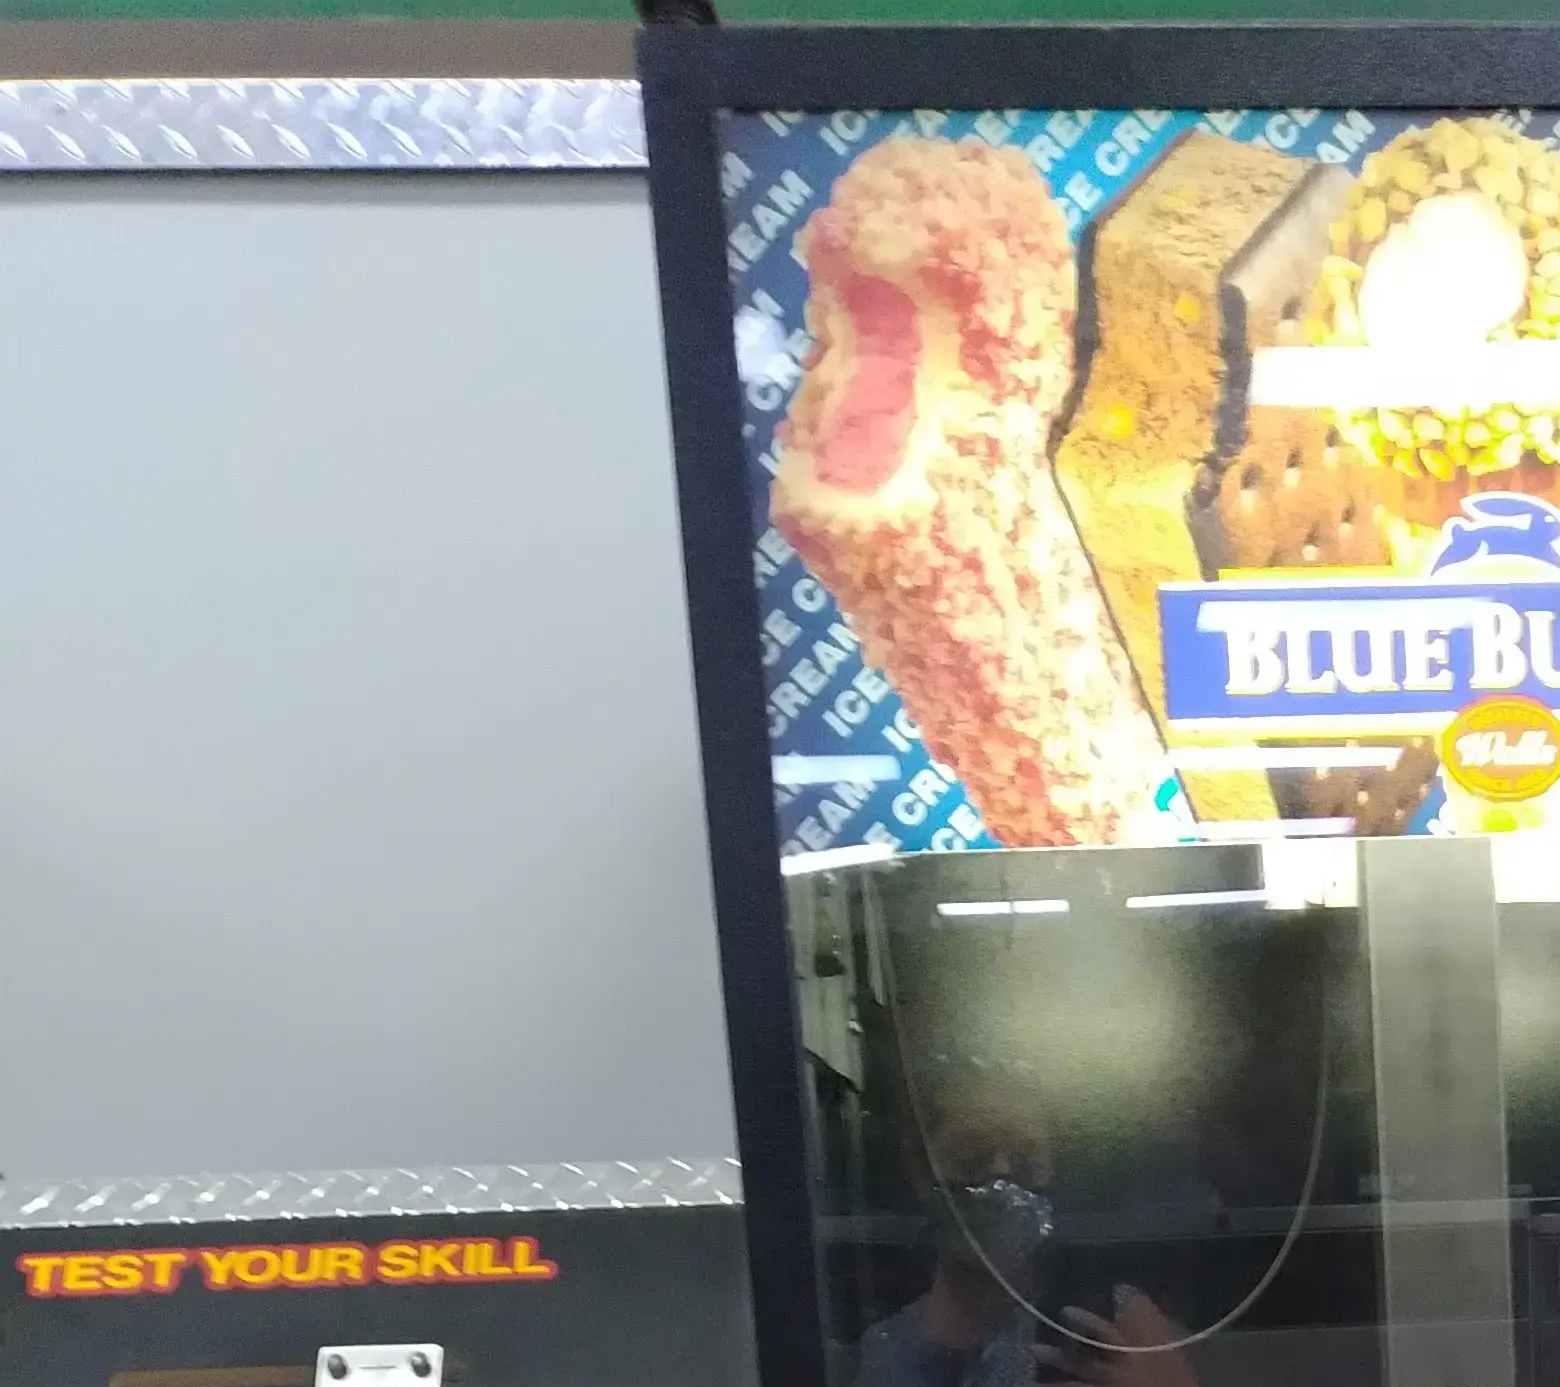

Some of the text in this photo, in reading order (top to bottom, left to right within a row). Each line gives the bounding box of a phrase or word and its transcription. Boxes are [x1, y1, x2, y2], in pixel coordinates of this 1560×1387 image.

[1222, 610, 1455, 696] BLUE
[822, 666, 892, 738] ICE
[16, 1236, 560, 1297] TEST YOUR SKILL
